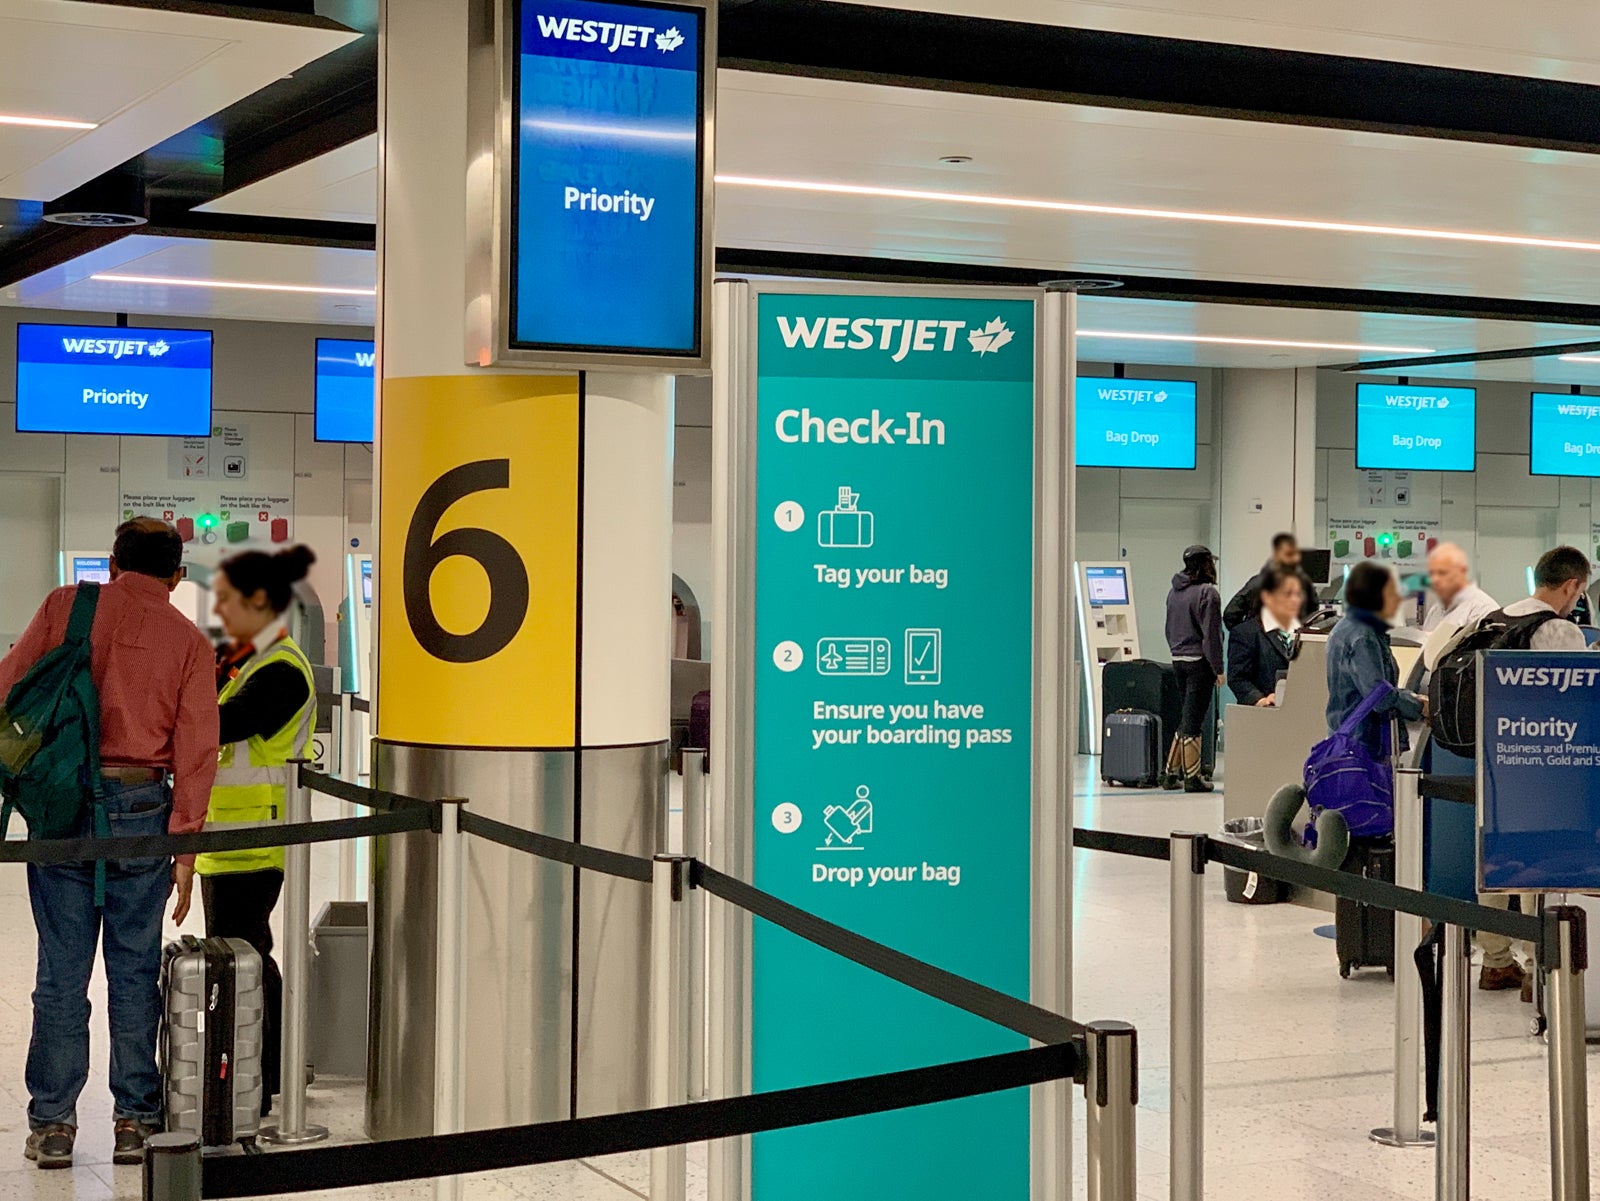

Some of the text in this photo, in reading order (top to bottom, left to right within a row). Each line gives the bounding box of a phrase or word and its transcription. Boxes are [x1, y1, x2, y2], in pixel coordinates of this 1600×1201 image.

[537, 15, 655, 53] WESTJET
[564, 186, 655, 221] Priority
[62, 338, 148, 359] WESTJET
[776, 316, 966, 362] WESTJET
[82, 387, 149, 409] Priority
[1097, 388, 1154, 405] WESTJET
[1385, 395, 1436, 411] WESTJET
[1557, 404, 1600, 420] WESTJE
[775, 408, 946, 445] Check-In
[1105, 430, 1159, 447] Bag Drop
[1392, 434, 1442, 450] Bag Drop
[1564, 442, 1583, 457] Bag
[403, 458, 530, 664] 6
[813, 564, 949, 590] Tag your bag
[783, 650, 793, 662] 2
[1495, 667, 1600, 693] WESTJET
[813, 700, 984, 724] Ensure you have
[812, 725, 1013, 749] your boarding pass
[1497, 717, 1578, 742] Priority
[1496, 743, 1542, 753] Business
[1543, 744, 1564, 753] and
[1496, 754, 1545, 767] Platinum,
[1546, 755, 1571, 765] Gold
[1572, 755, 1593, 766] and
[783, 811, 792, 824] 3
[812, 862, 961, 887] Drop your bag
